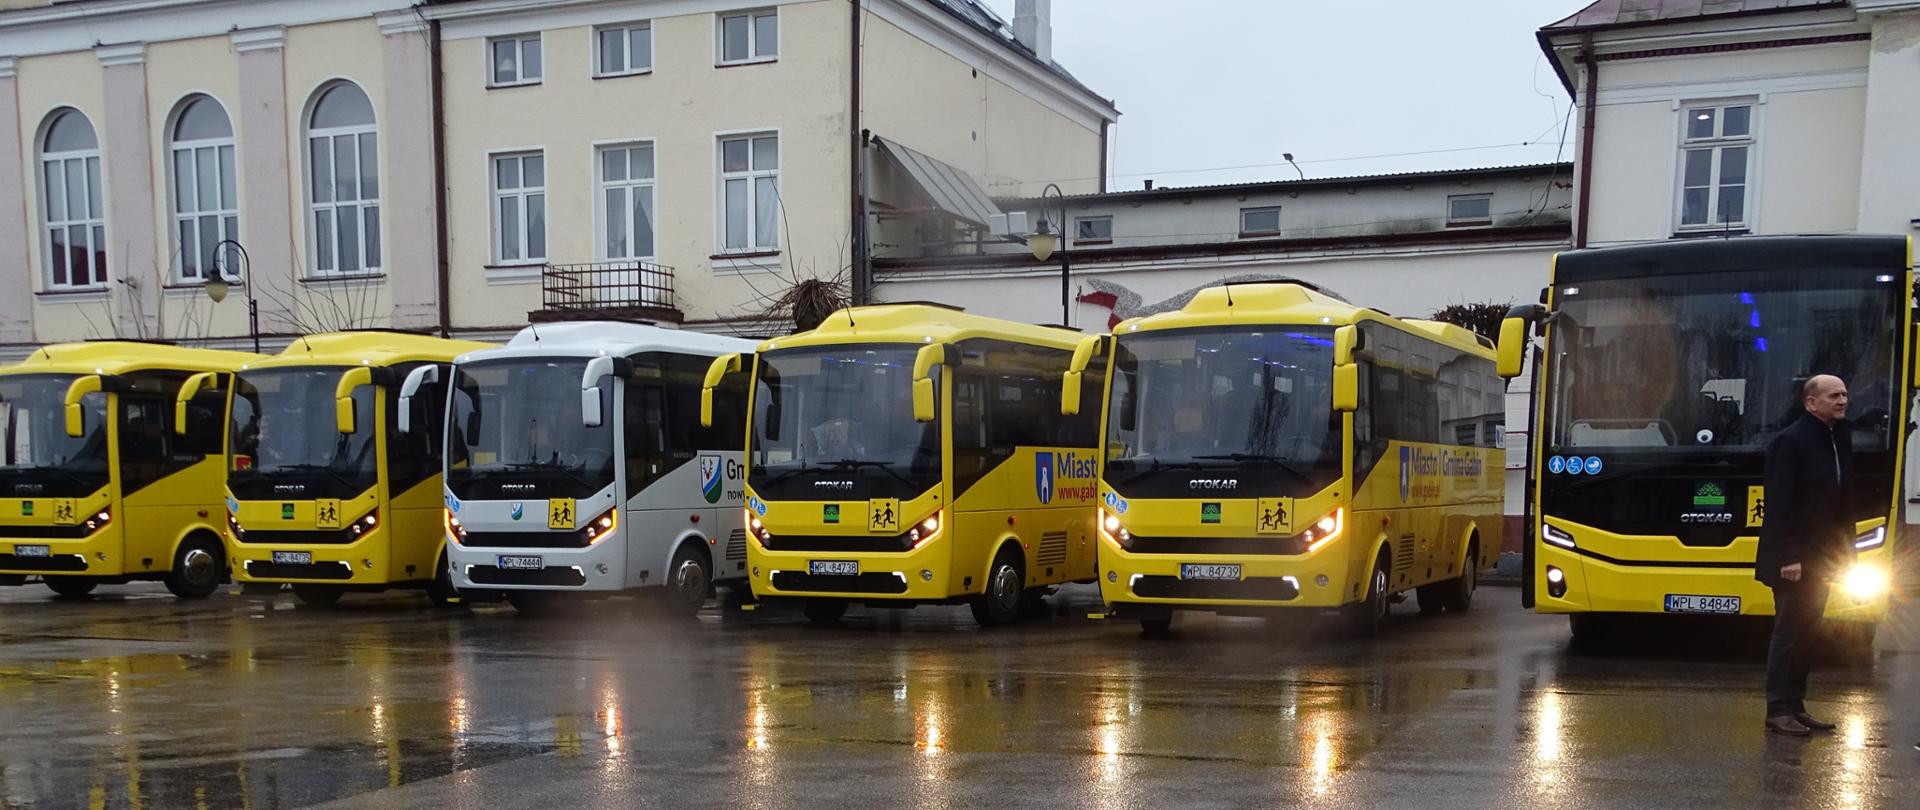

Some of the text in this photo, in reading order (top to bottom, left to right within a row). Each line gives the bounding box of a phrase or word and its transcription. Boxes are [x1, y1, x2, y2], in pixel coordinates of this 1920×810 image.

[1057, 452, 1098, 479] Miast
[814, 481, 853, 490] OTOKAR
[1189, 479, 1238, 489] OTOKAR
[1680, 513, 1733, 523] OTOKAR
[814, 562, 857, 573] WPL 84738
[1187, 565, 1239, 577] WPL 84739
[1672, 597, 1738, 610] WPL 84845
